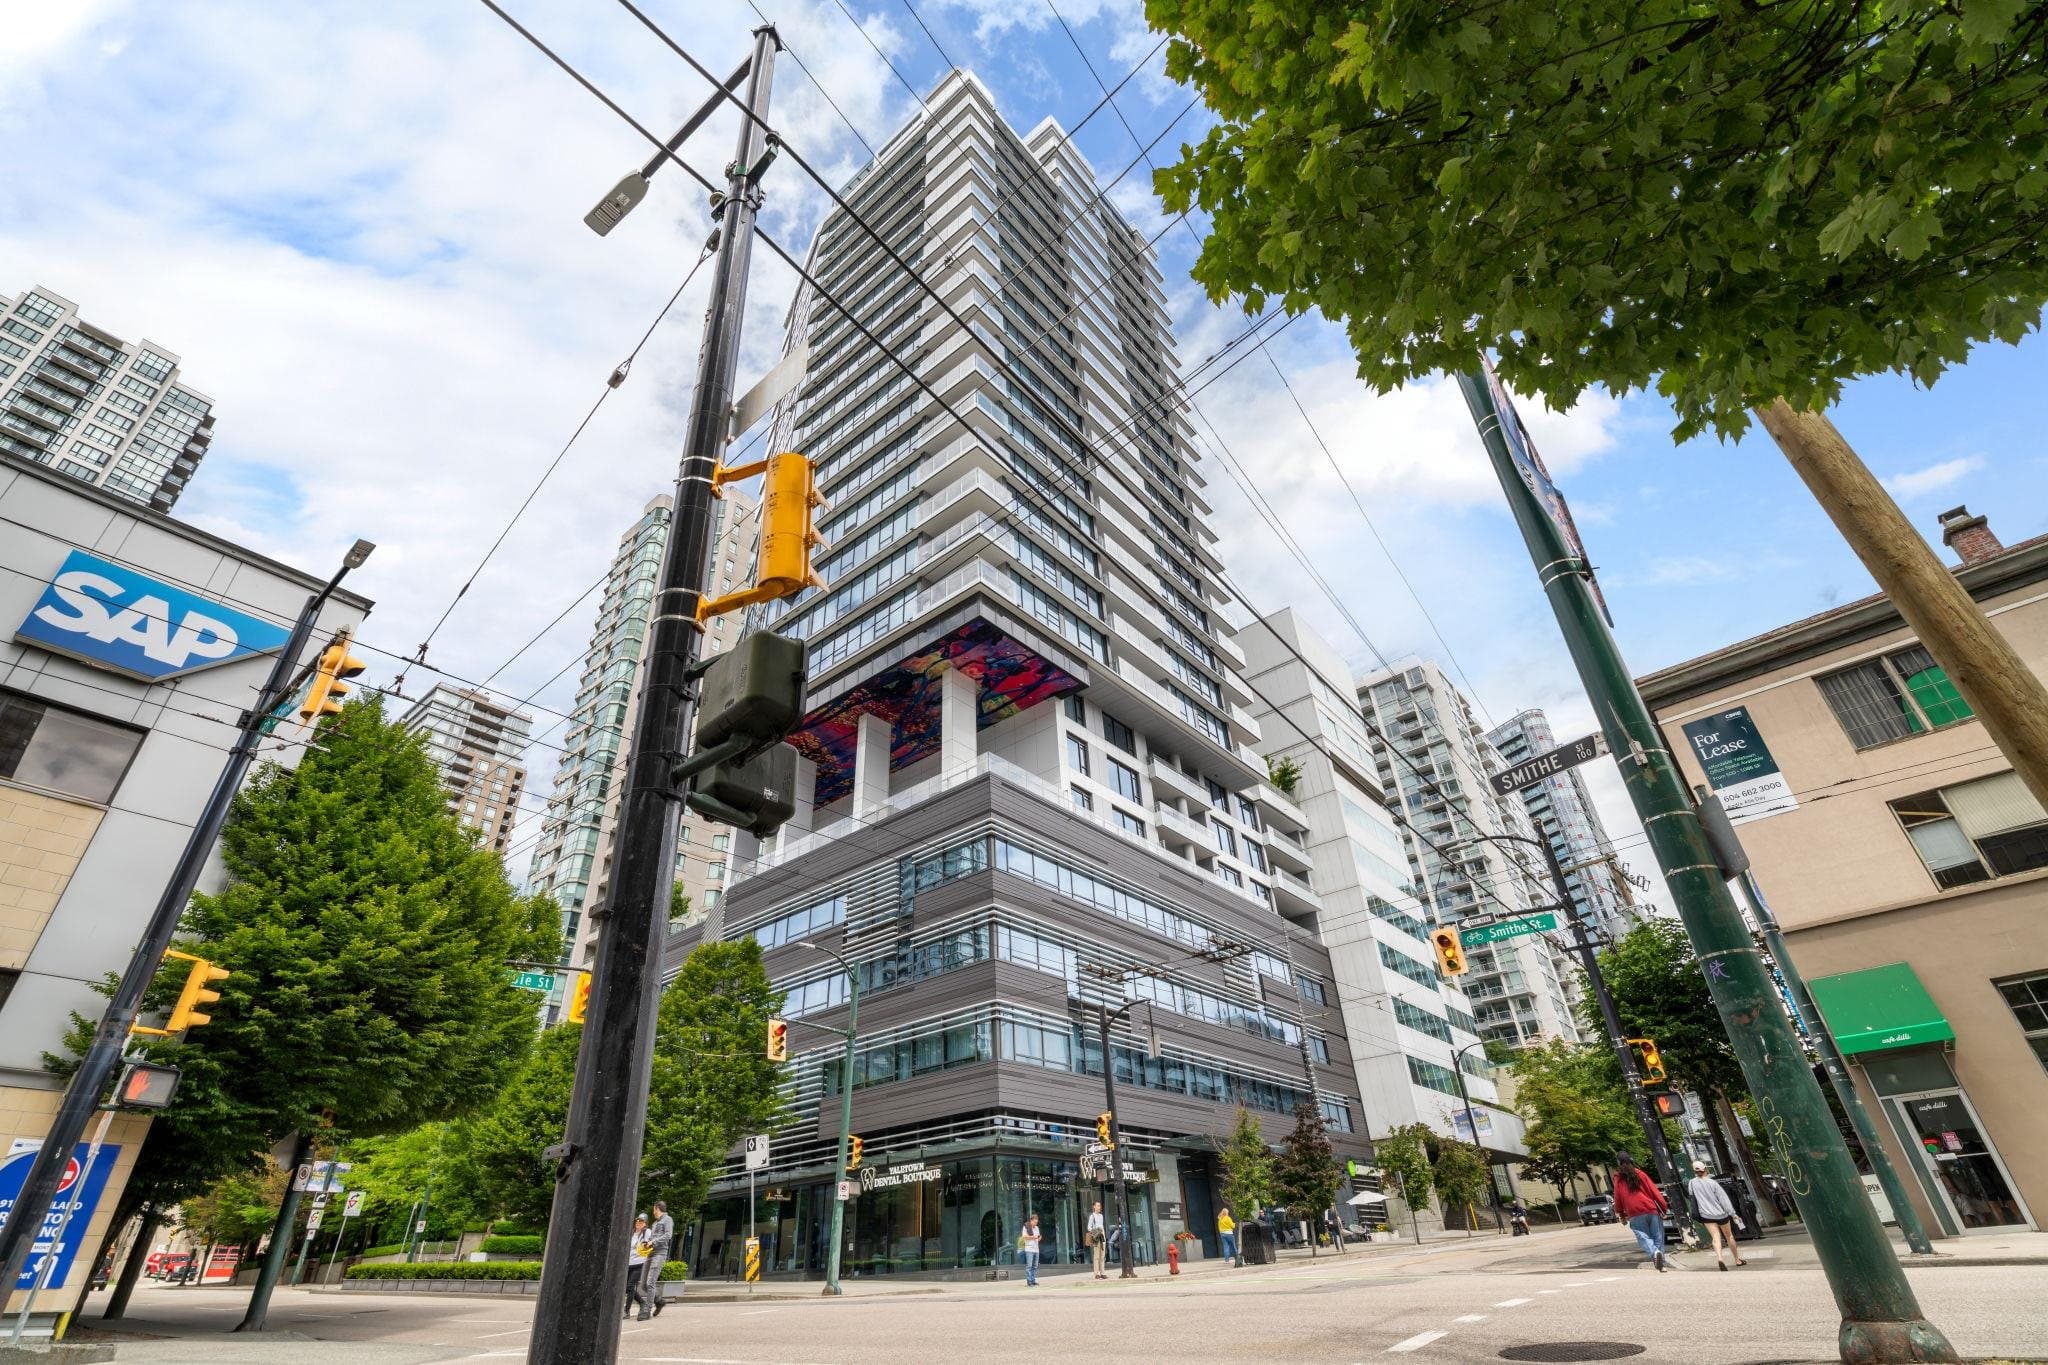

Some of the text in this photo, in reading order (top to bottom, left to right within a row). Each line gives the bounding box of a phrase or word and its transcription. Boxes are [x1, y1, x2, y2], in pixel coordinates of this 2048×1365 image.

[34, 571, 239, 668] SAP
[1693, 732, 1720, 748] For
[1576, 748, 1592, 761] 100
[1700, 739, 1748, 761] Lease
[1501, 753, 1562, 790] SMITHE
[1723, 793, 1741, 803] 604
[1758, 781, 1782, 792] 3000
[1489, 919, 1547, 938] Smithe St.
[537, 976, 550, 989] St
[873, 1175, 902, 1188] DENTAL
[902, 1168, 942, 1184] BOUTIQUE
[888, 1162, 925, 1175] YALETOWN
